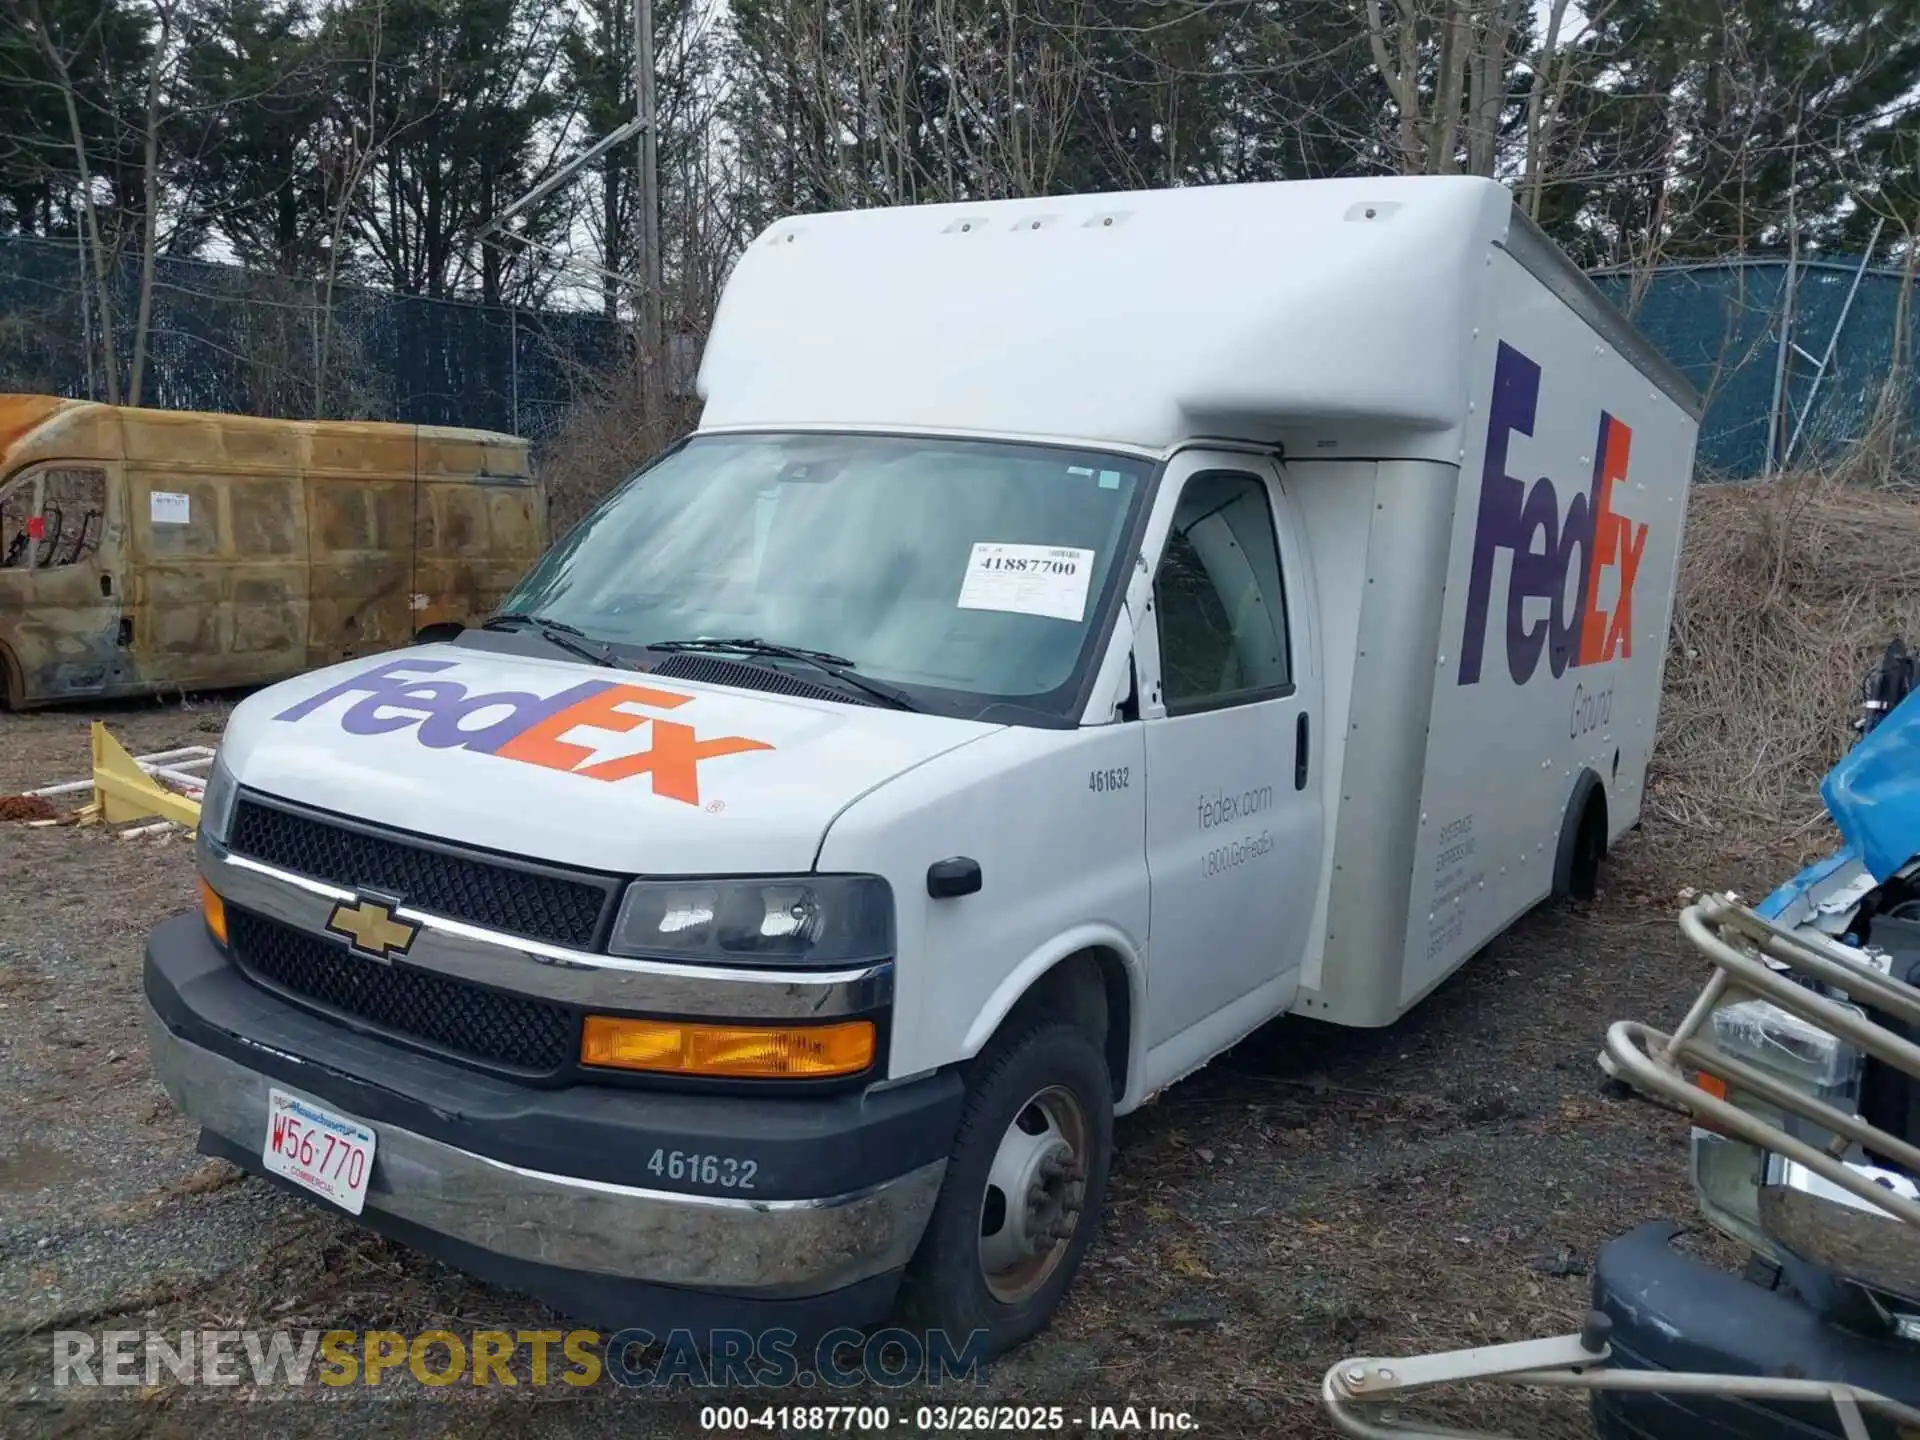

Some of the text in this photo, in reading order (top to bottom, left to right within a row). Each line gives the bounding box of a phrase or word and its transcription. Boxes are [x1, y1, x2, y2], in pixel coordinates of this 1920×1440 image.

[1457, 339, 1648, 686] FedEx
[980, 557, 1076, 576] 41887700
[1569, 673, 1615, 740] Ground
[272, 659, 776, 806] FedEx
[1089, 766, 1129, 792] 461632
[1198, 786, 1273, 829] fedex.com
[647, 1148, 758, 1188] 461632
